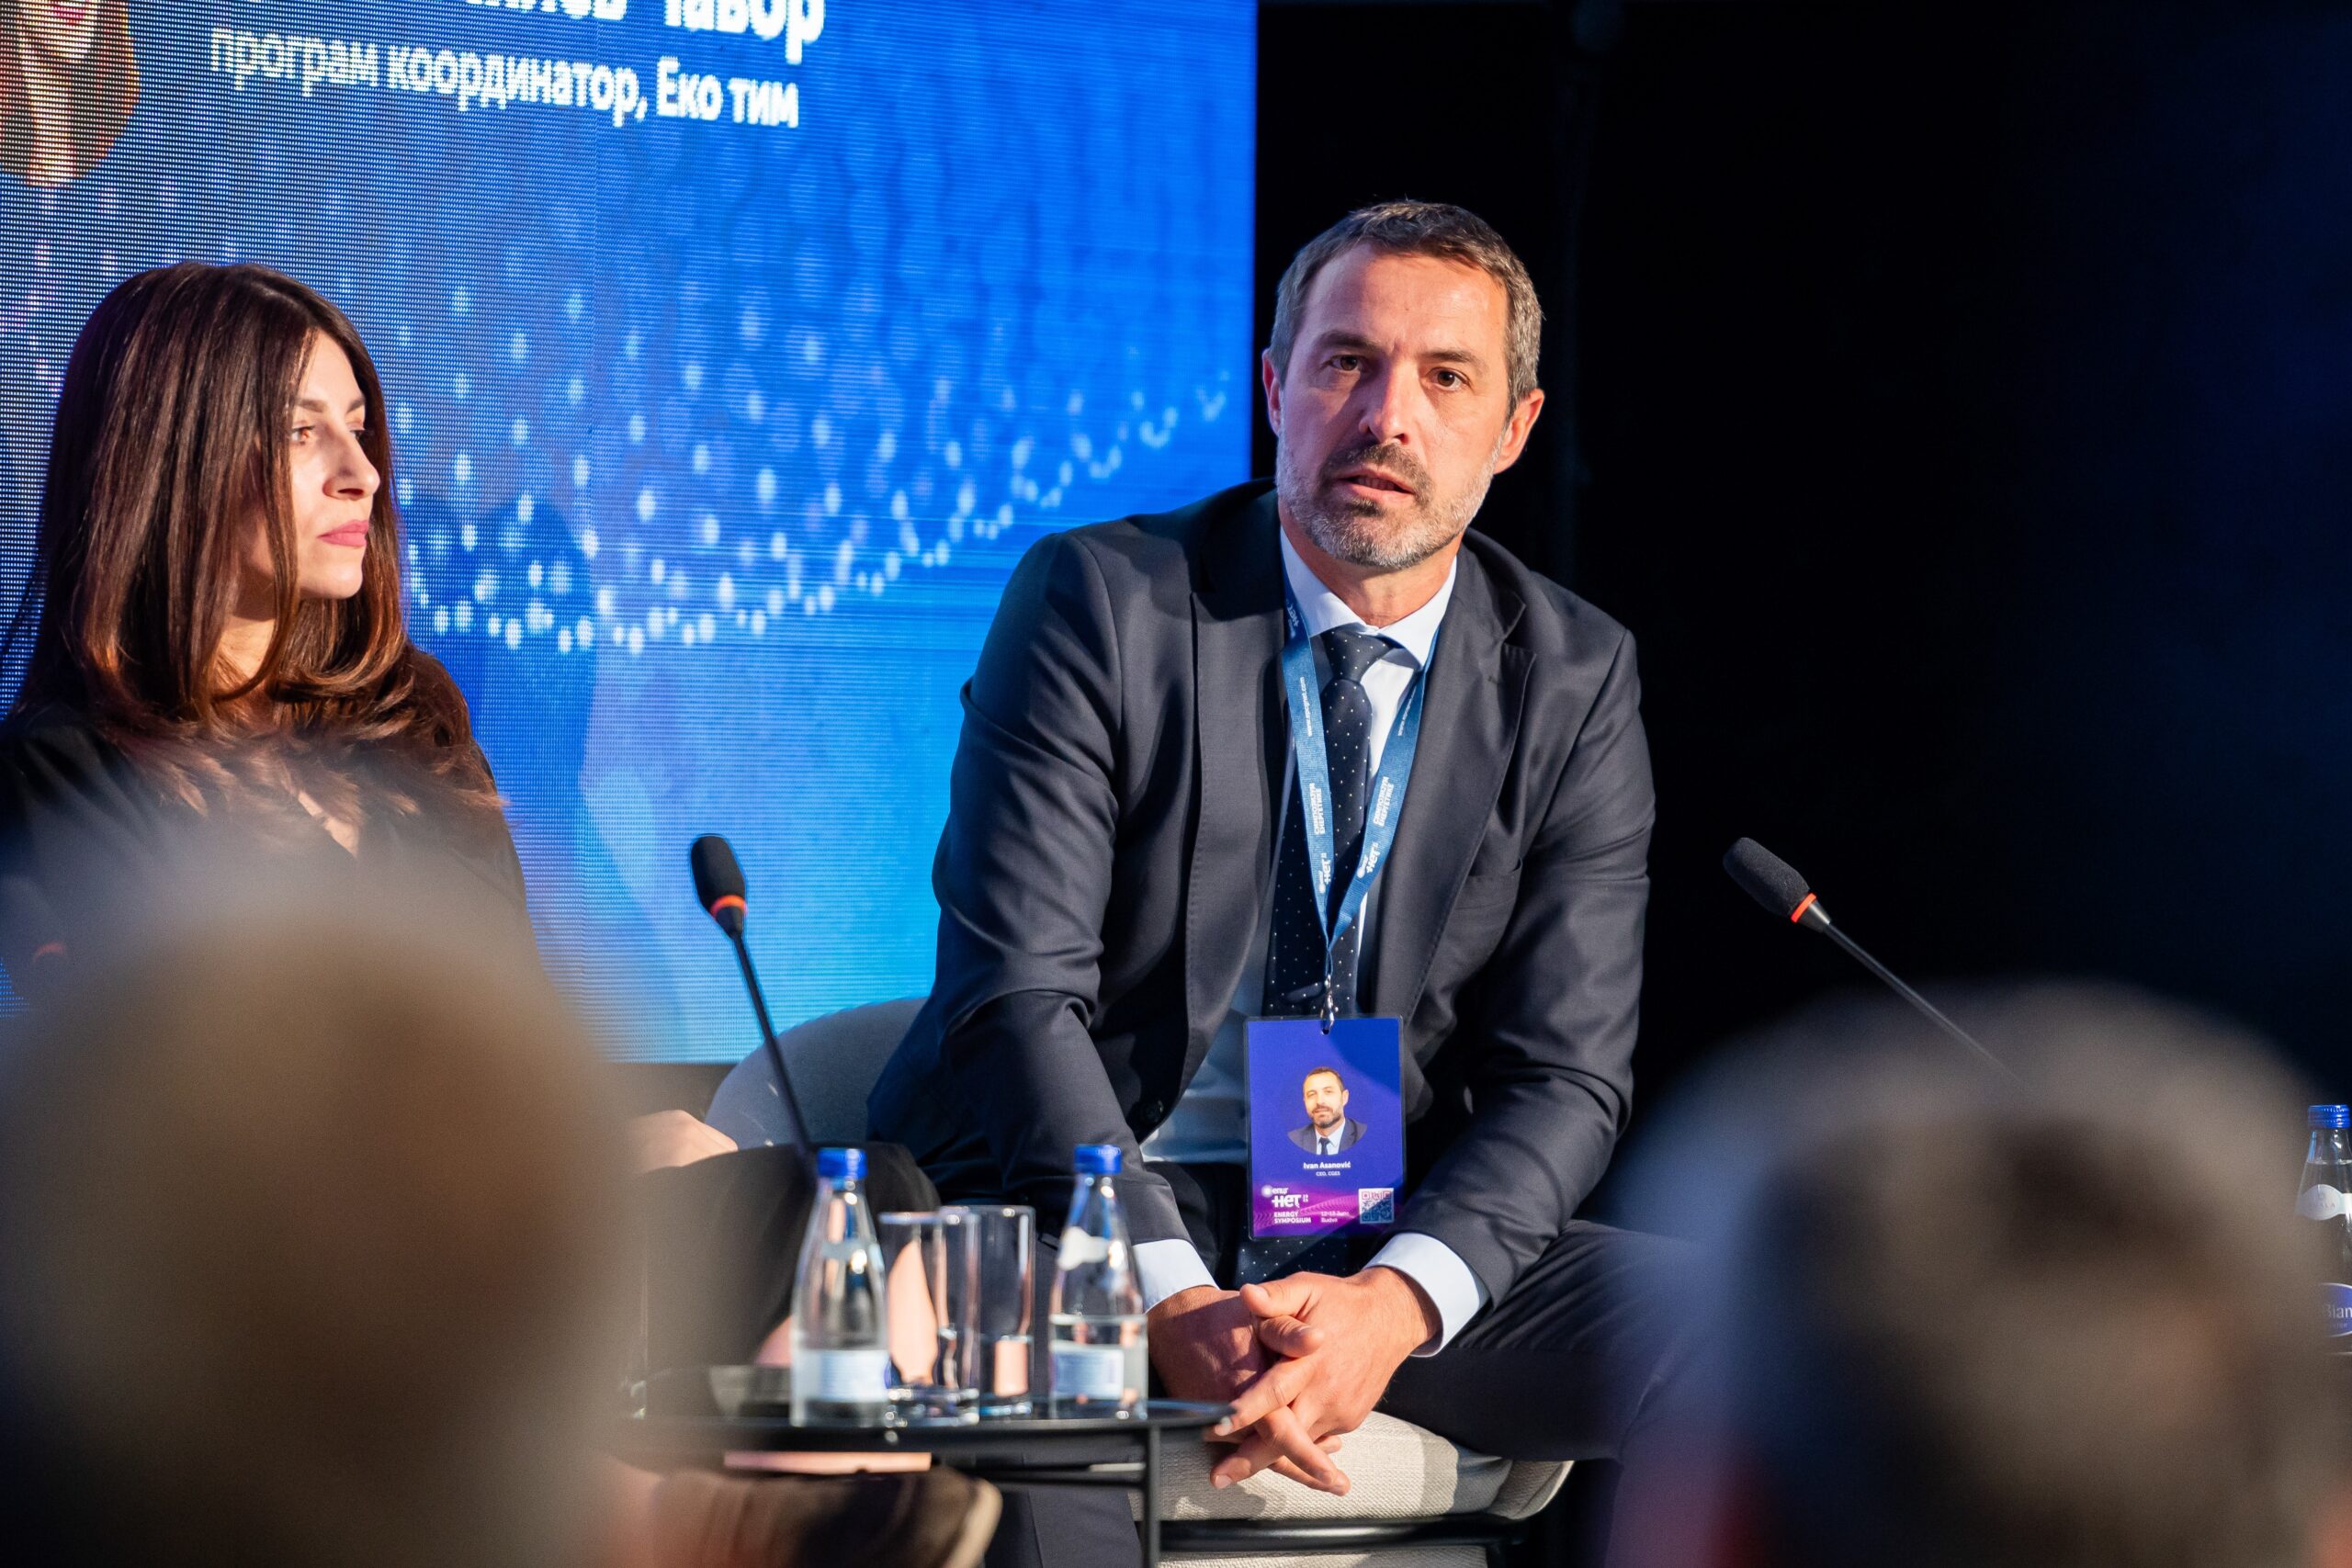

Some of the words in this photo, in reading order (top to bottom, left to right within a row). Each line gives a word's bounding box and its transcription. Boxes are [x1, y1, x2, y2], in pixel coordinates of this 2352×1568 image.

[210, 28, 379, 96] програм
[387, 44, 649, 127] координатор,
[656, 57, 723, 119] Еко
[729, 78, 799, 128] тим
